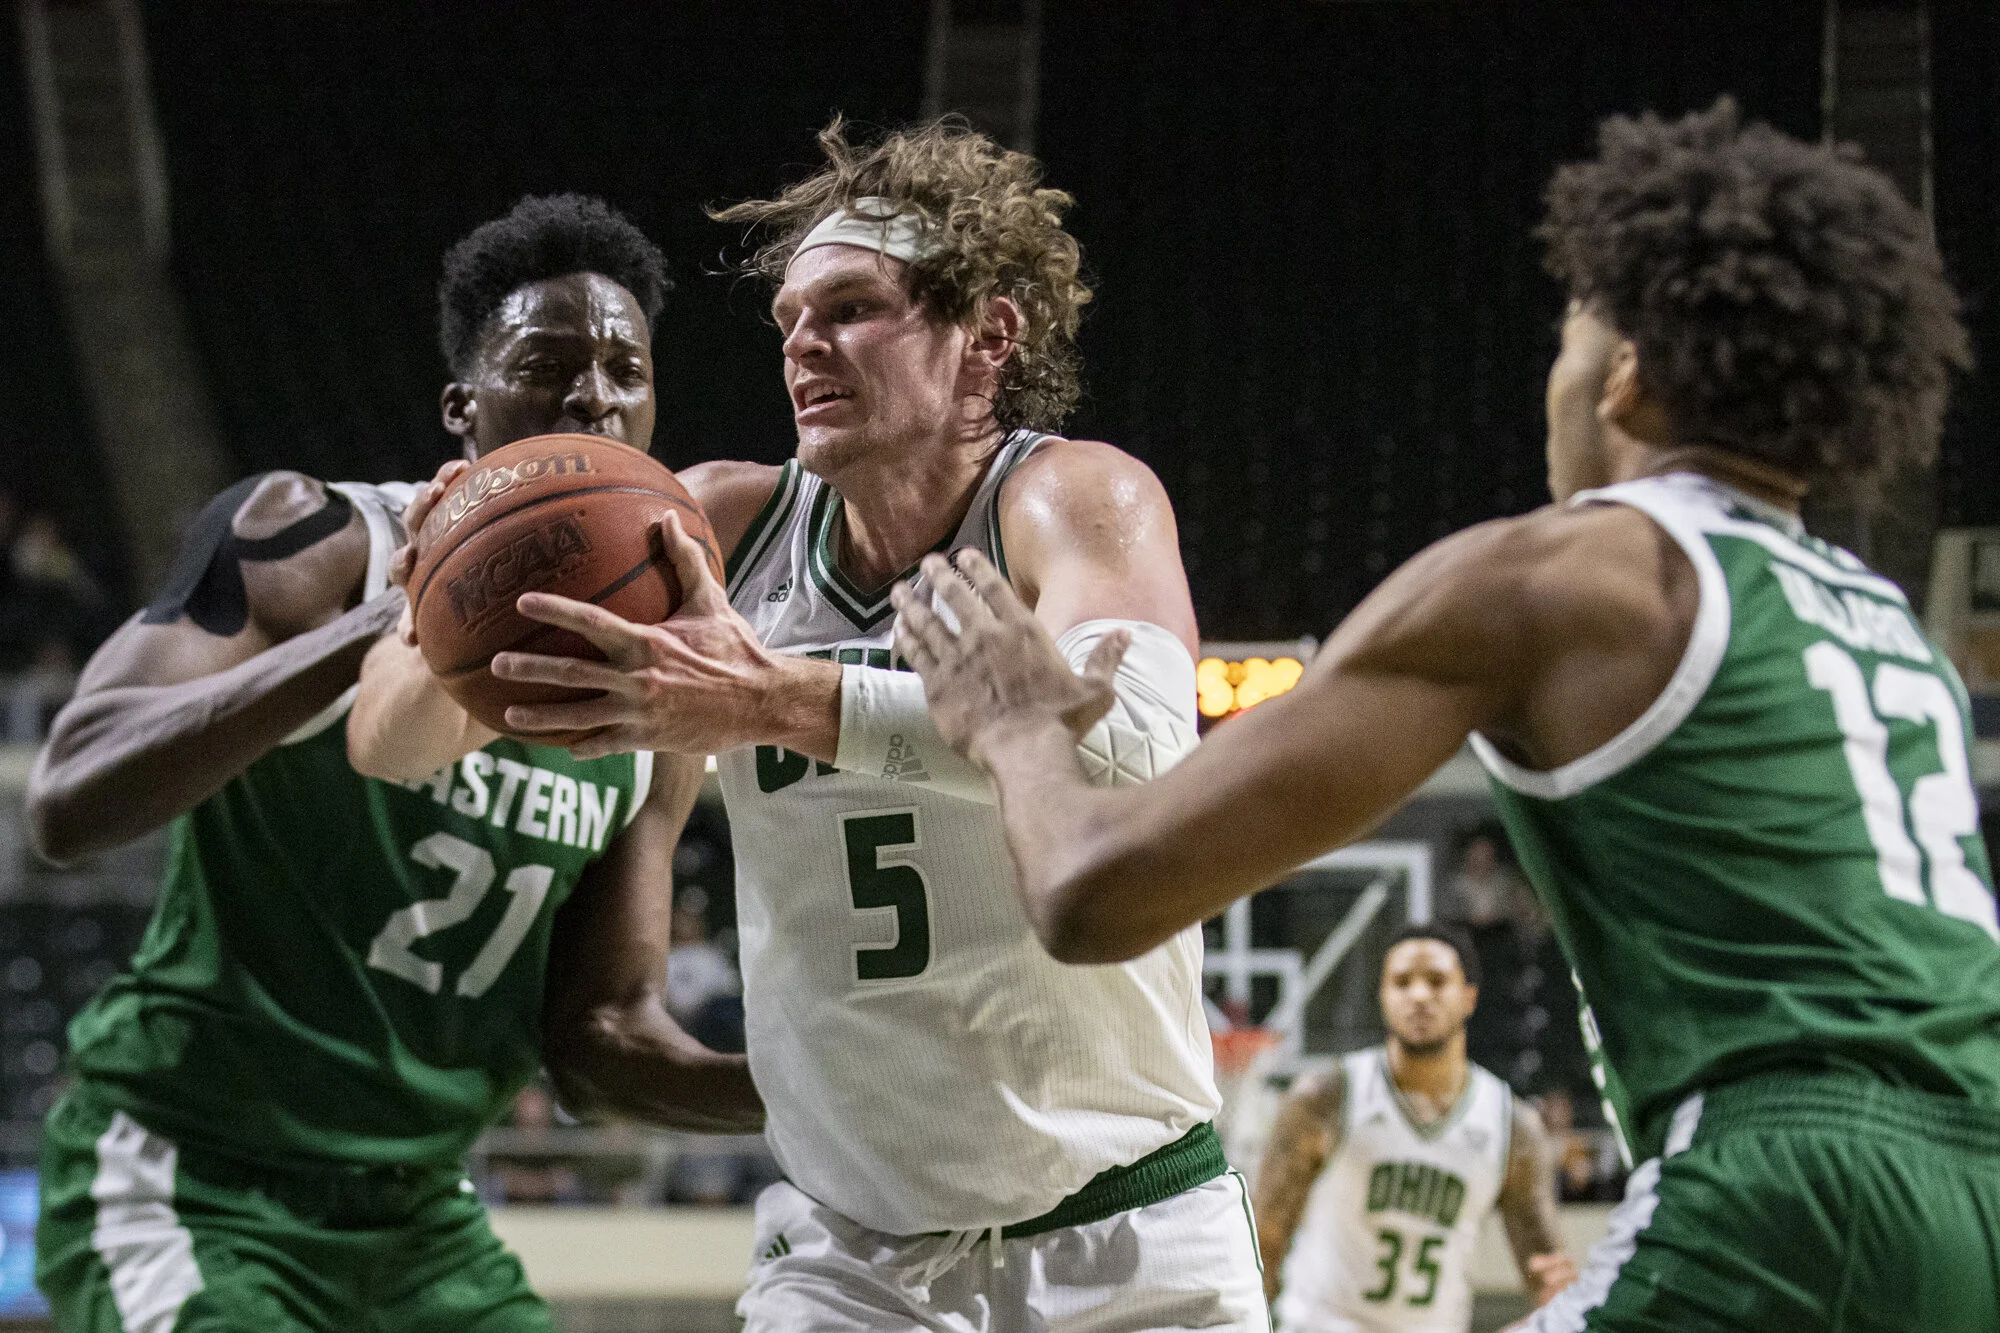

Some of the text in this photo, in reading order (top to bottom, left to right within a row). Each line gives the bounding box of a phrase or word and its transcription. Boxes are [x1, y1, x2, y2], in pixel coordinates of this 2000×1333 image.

[403, 748, 619, 851] ASTERN
[1803, 641, 2000, 945] 12
[366, 831, 555, 998] 21
[841, 810, 934, 983] 5
[1366, 1160, 1466, 1229] OHIO
[1363, 1228, 1444, 1306] 35
